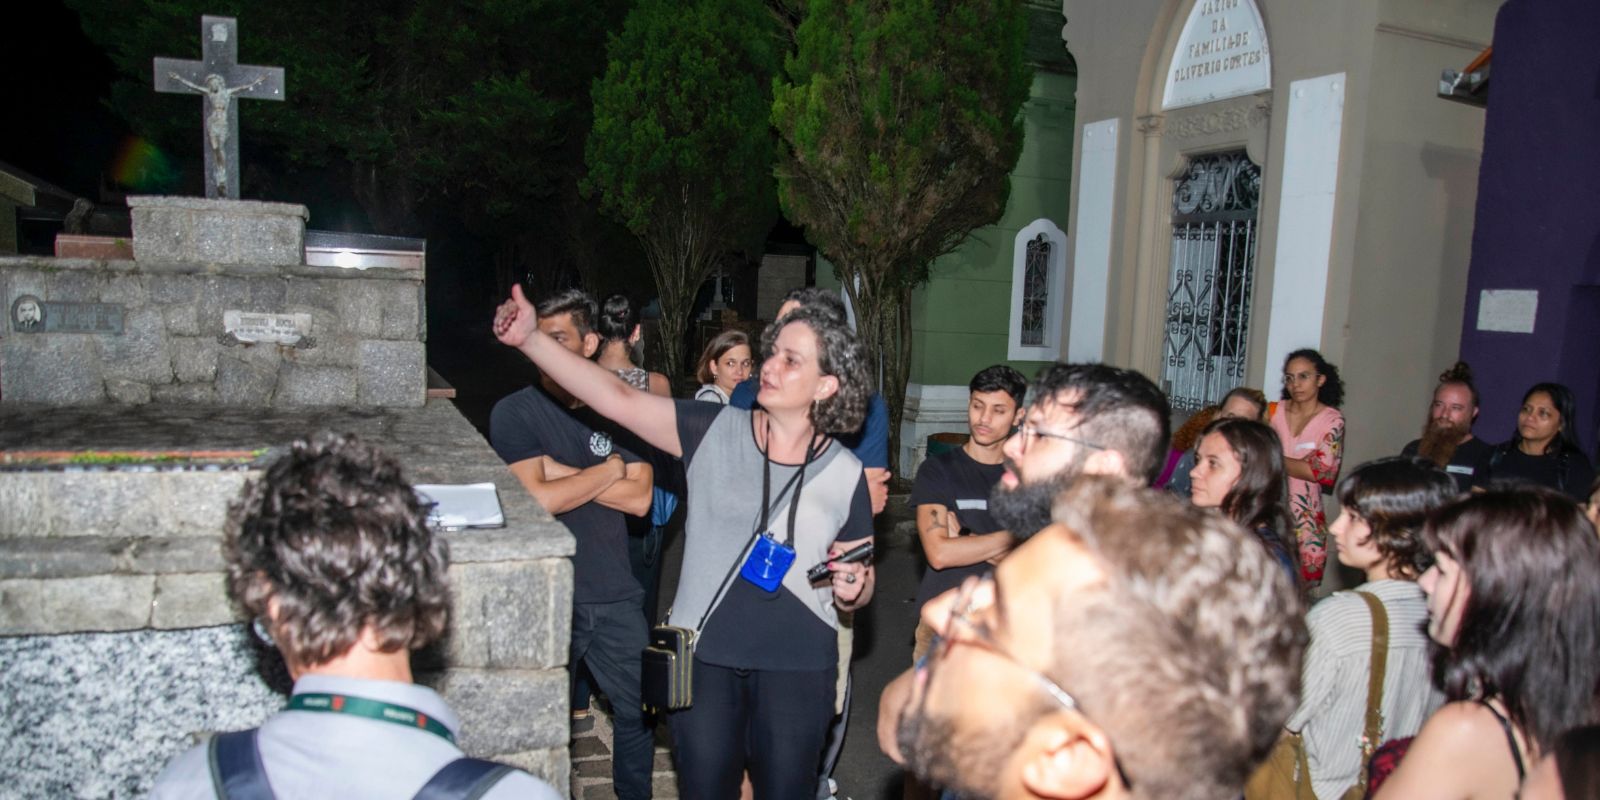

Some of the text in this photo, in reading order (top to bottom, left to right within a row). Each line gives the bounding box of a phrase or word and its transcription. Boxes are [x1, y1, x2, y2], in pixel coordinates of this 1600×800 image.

[1212, 17, 1226, 34] DA
[1174, 49, 1261, 83] OLIVERIO CORTES
